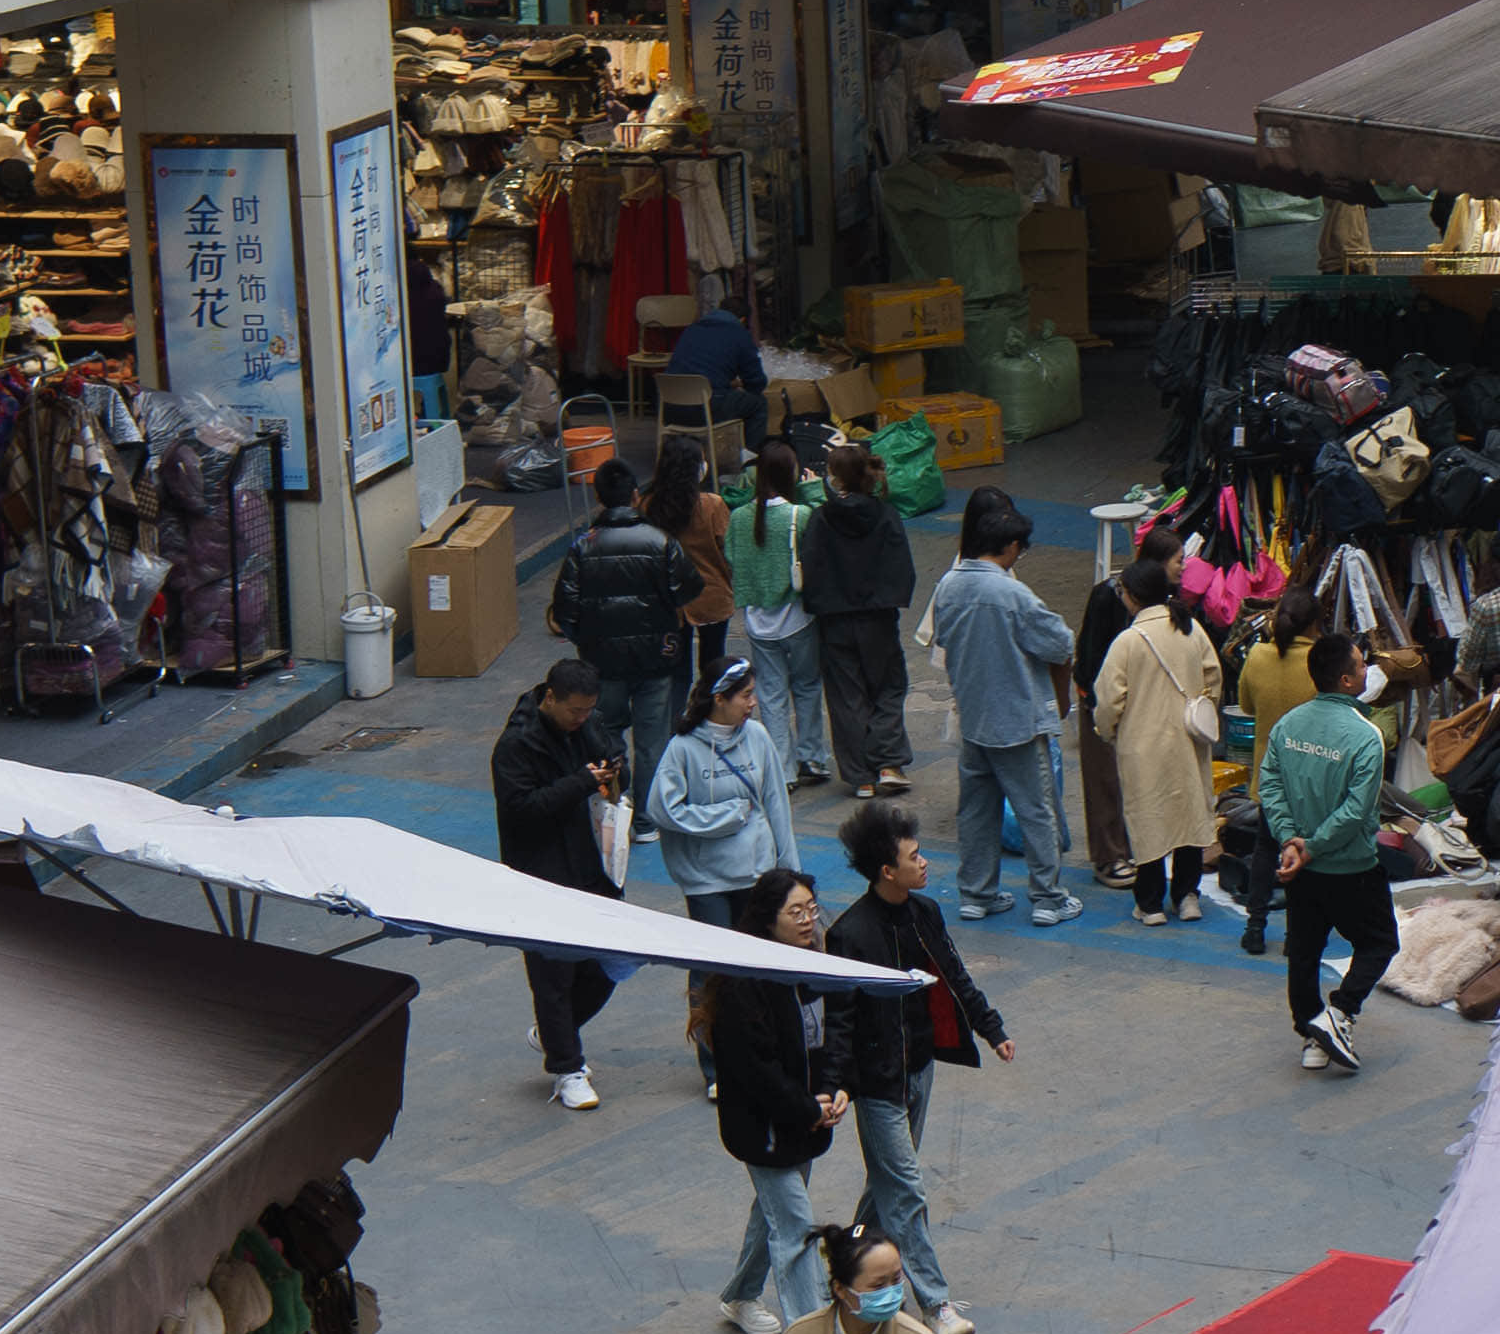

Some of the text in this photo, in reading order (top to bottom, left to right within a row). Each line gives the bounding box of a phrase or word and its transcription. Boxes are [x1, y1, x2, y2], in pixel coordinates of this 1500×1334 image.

[711, 7, 747, 114] 金荷花
[182, 193, 230, 330] 金荷花
[232, 194, 275, 383] 时尚饰品城
[349, 167, 372, 311] 金荷花
